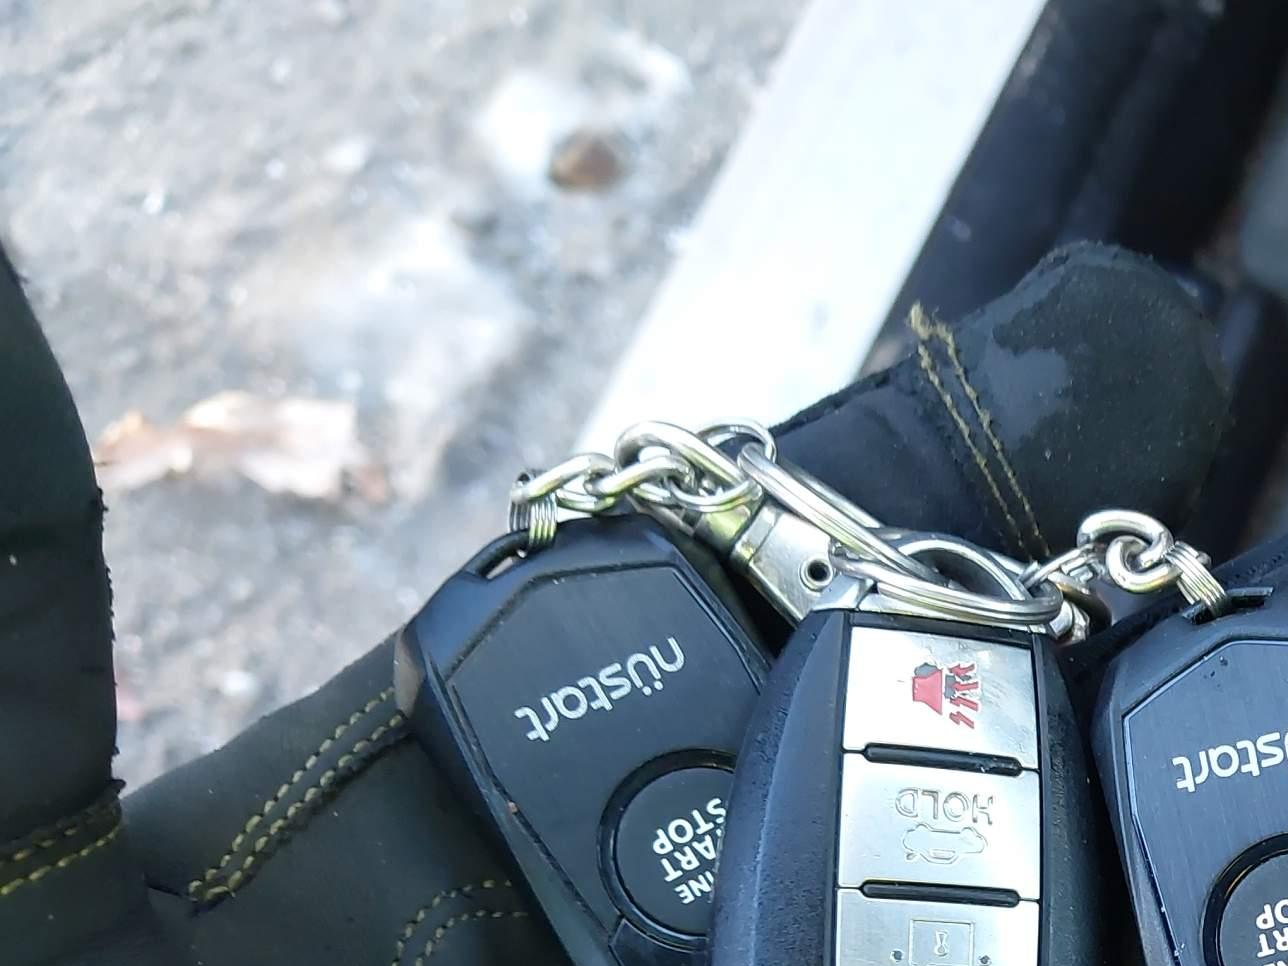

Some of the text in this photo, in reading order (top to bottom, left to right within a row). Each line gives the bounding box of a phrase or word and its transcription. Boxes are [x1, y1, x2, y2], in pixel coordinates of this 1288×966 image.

[514, 636, 685, 742] nüstart
[652, 797, 727, 855] STOP
[894, 787, 994, 826] HOLD
[660, 828, 722, 883] ART
